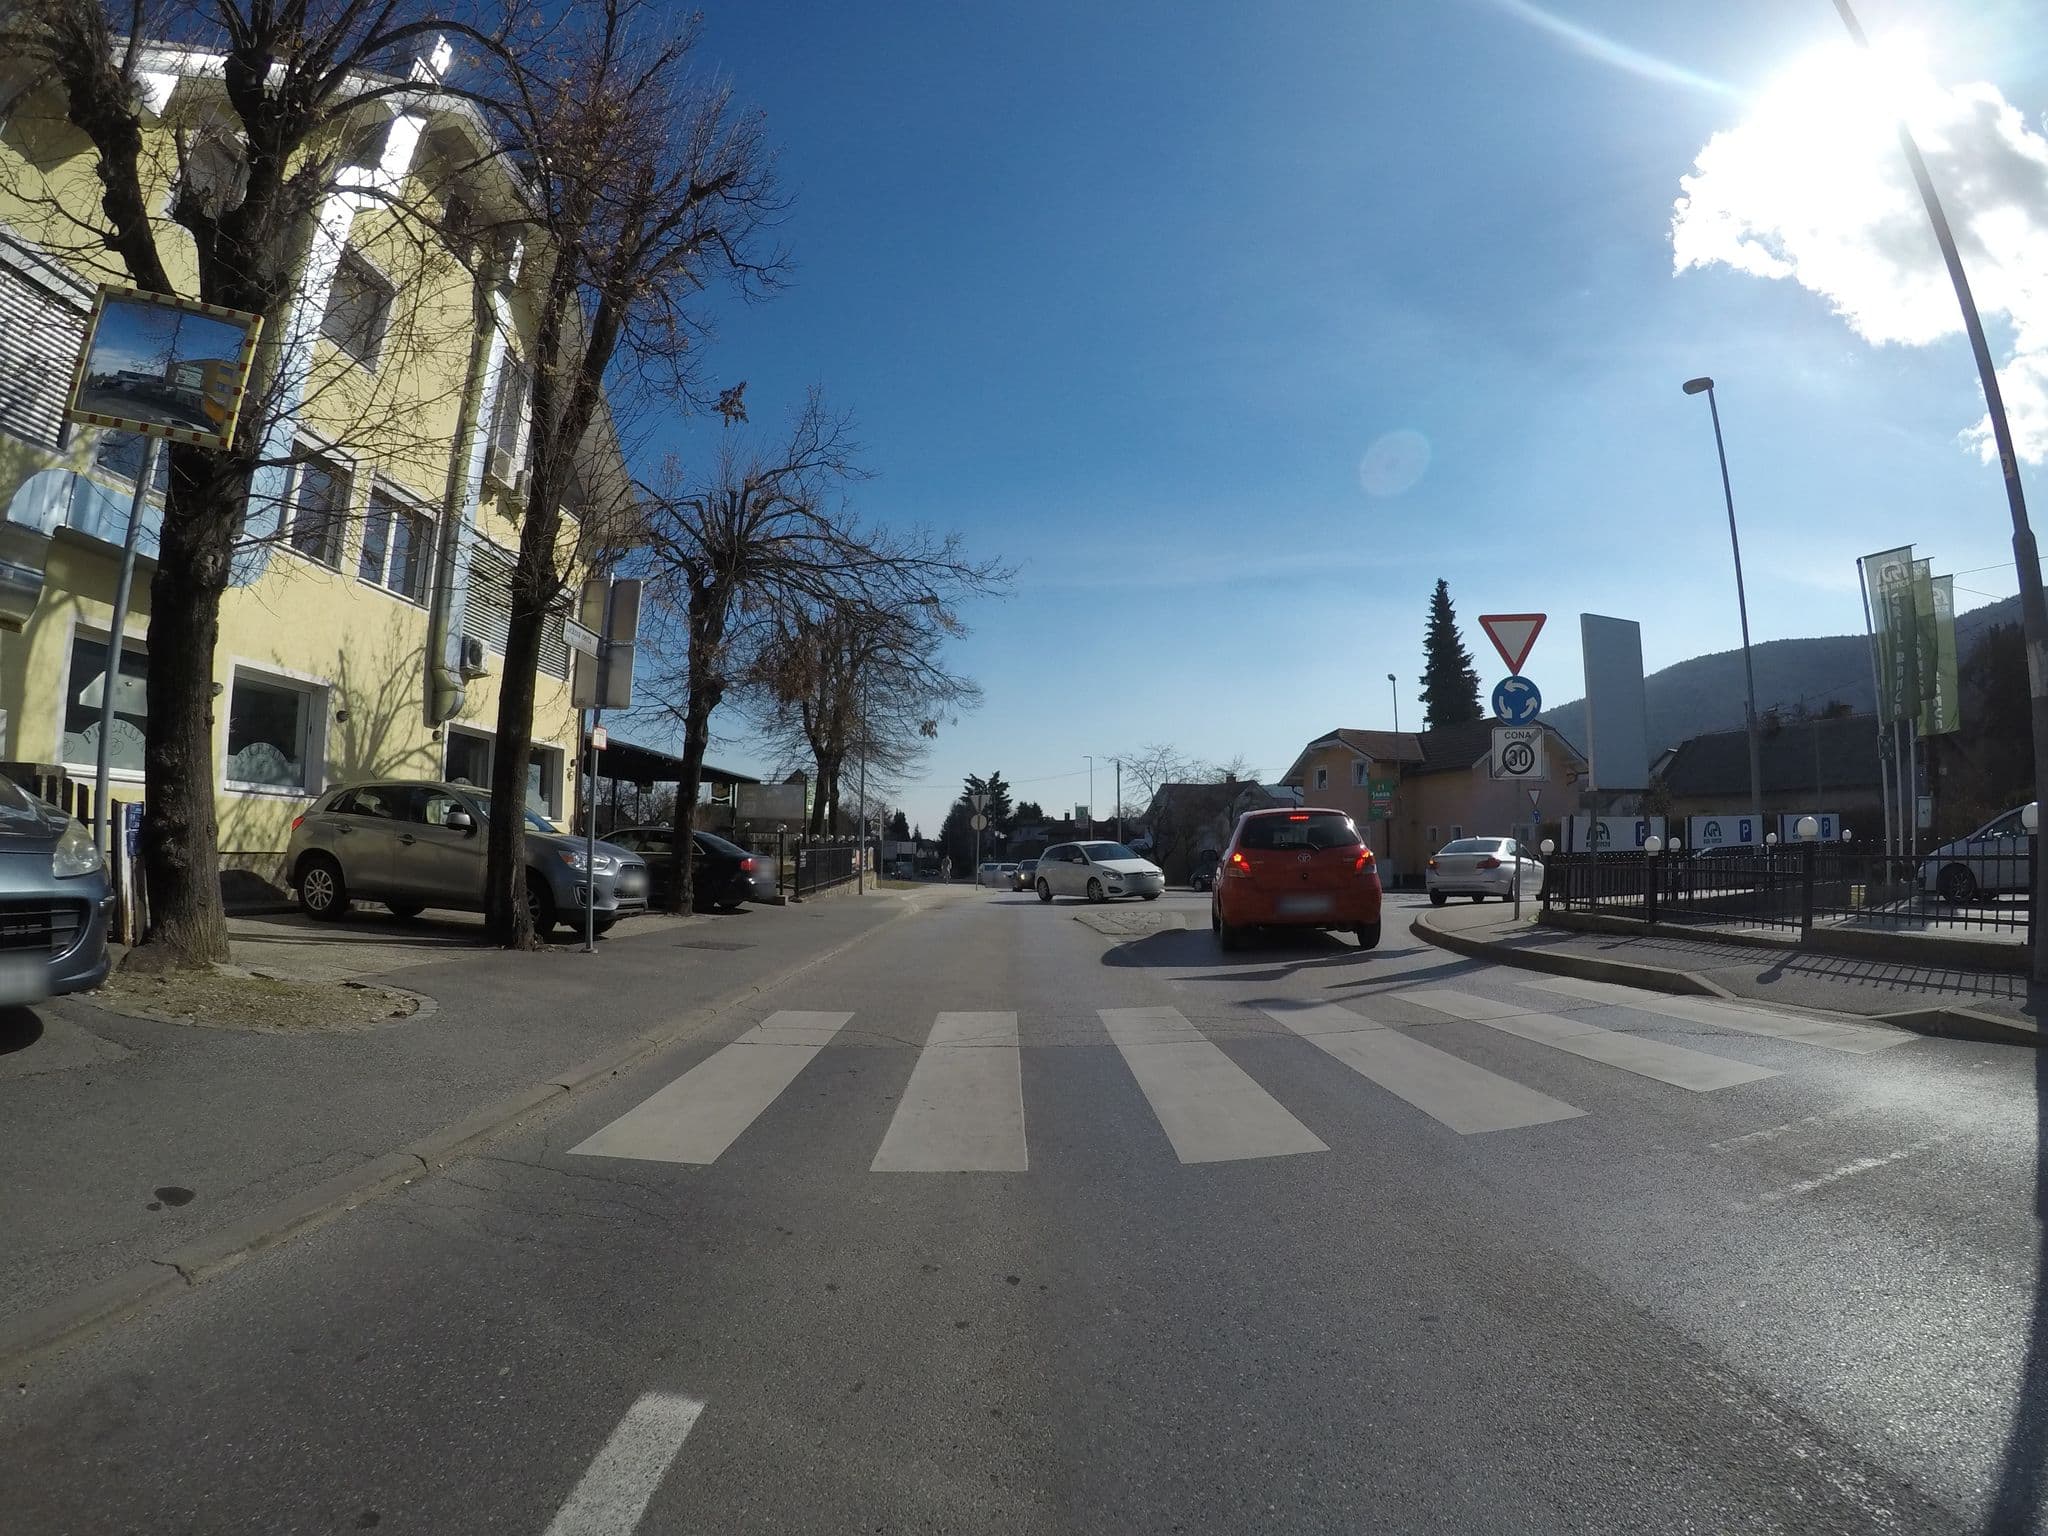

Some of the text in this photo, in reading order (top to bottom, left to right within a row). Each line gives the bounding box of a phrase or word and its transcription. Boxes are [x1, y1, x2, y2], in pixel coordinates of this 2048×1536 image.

[83, 721, 146, 753] PIERIJA
[1504, 731, 1531, 739] CONA
[1508, 749, 1528, 767] 30
